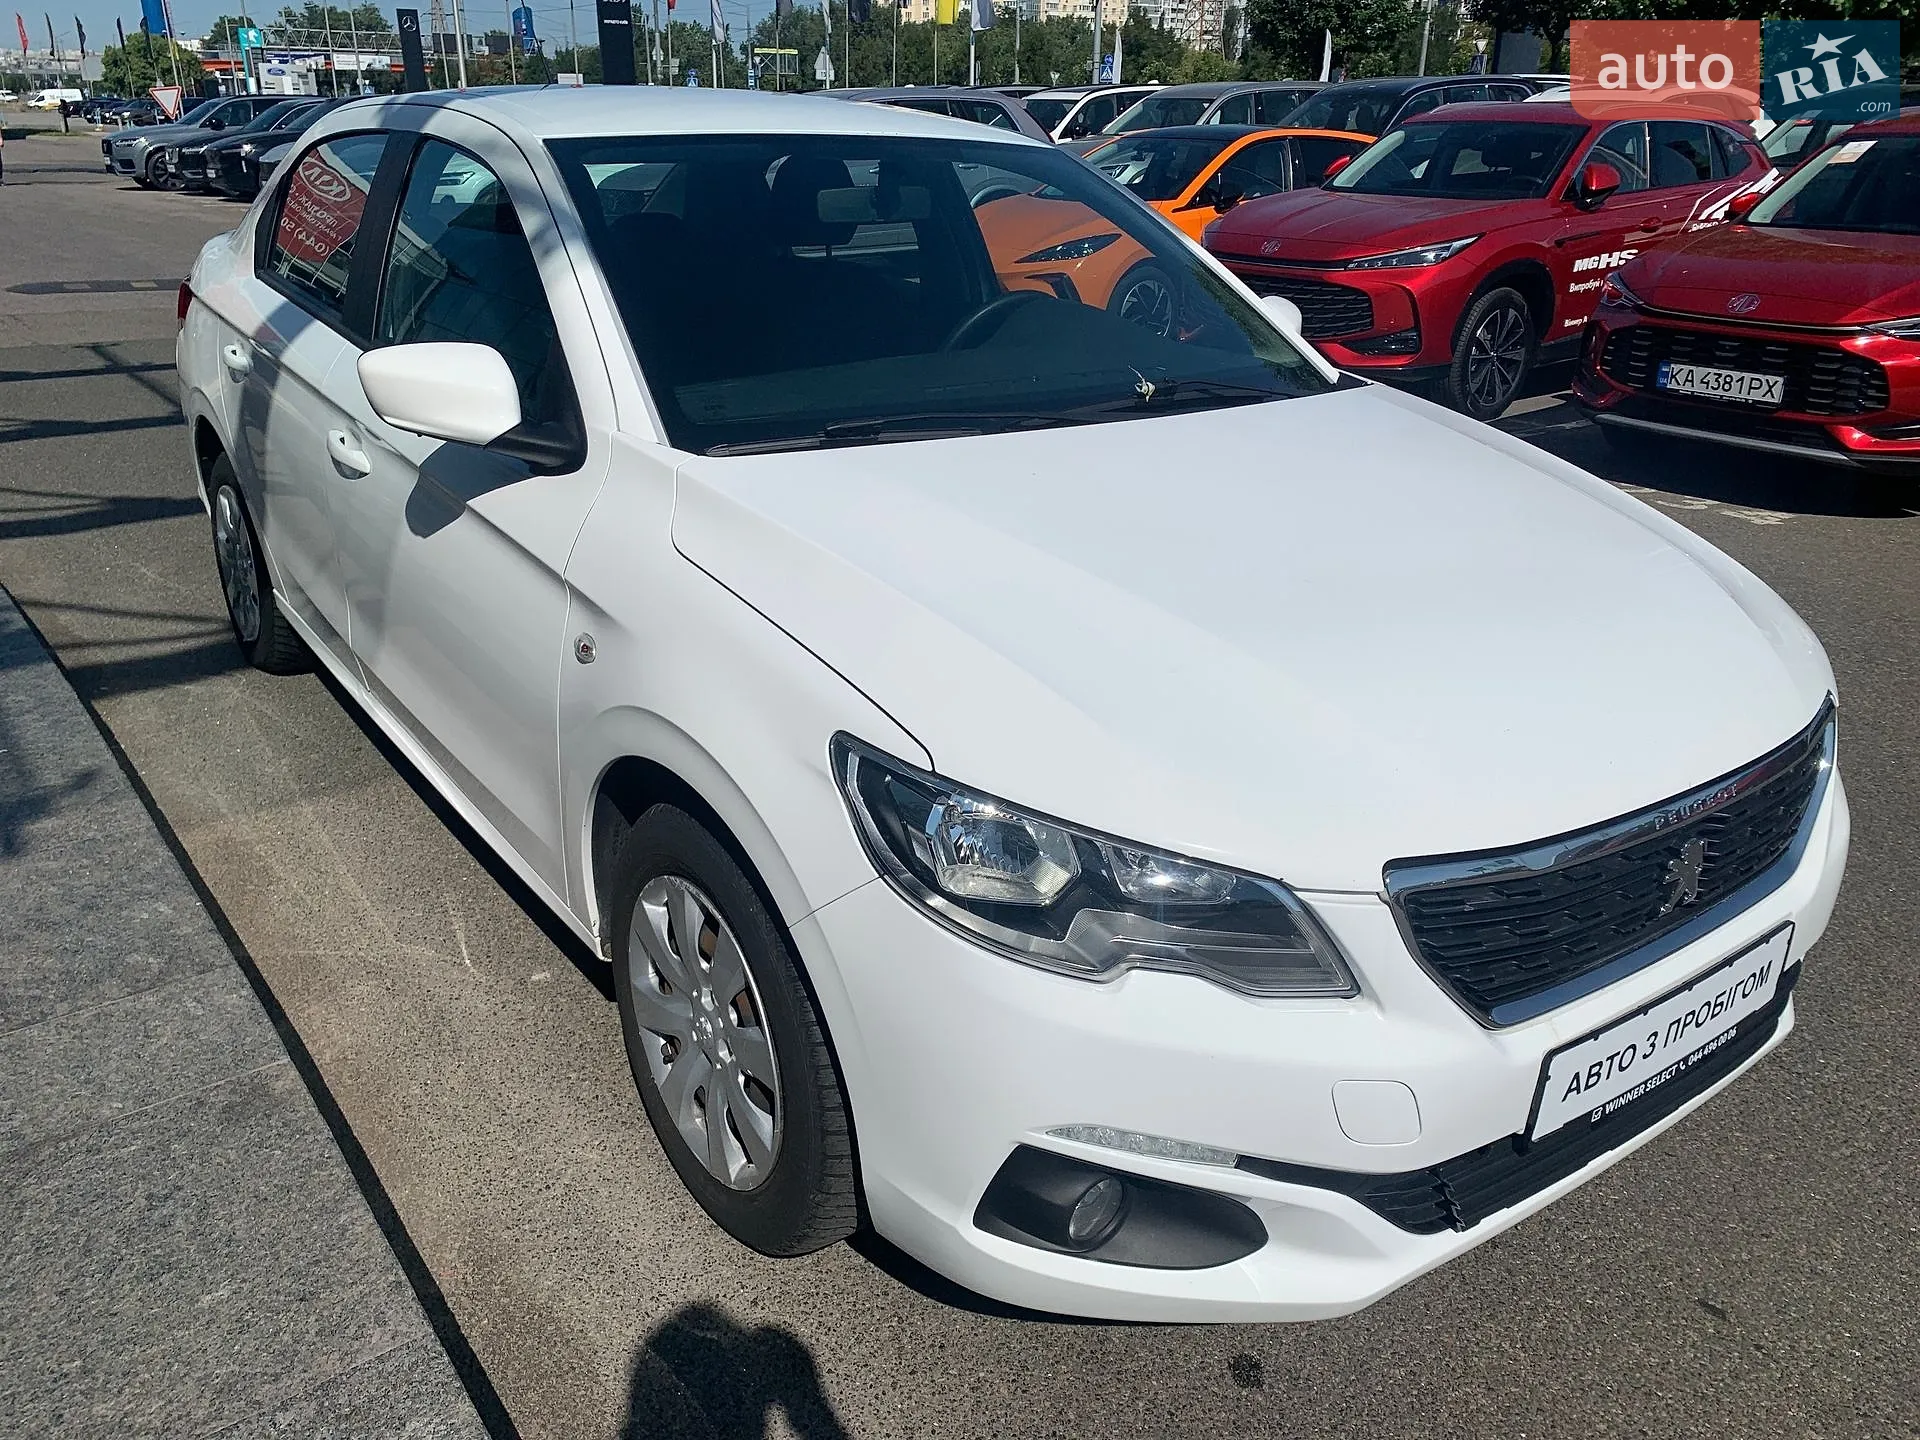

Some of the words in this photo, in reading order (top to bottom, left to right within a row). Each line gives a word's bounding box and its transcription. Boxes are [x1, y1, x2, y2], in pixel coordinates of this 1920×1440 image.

[1562, 1043, 1636, 1103] АВТО
[1663, 959, 1773, 1049] ПРОБІГОМ
[1605, 1084, 1646, 1114] WINNER
[1645, 1064, 1679, 1092] SELECT
